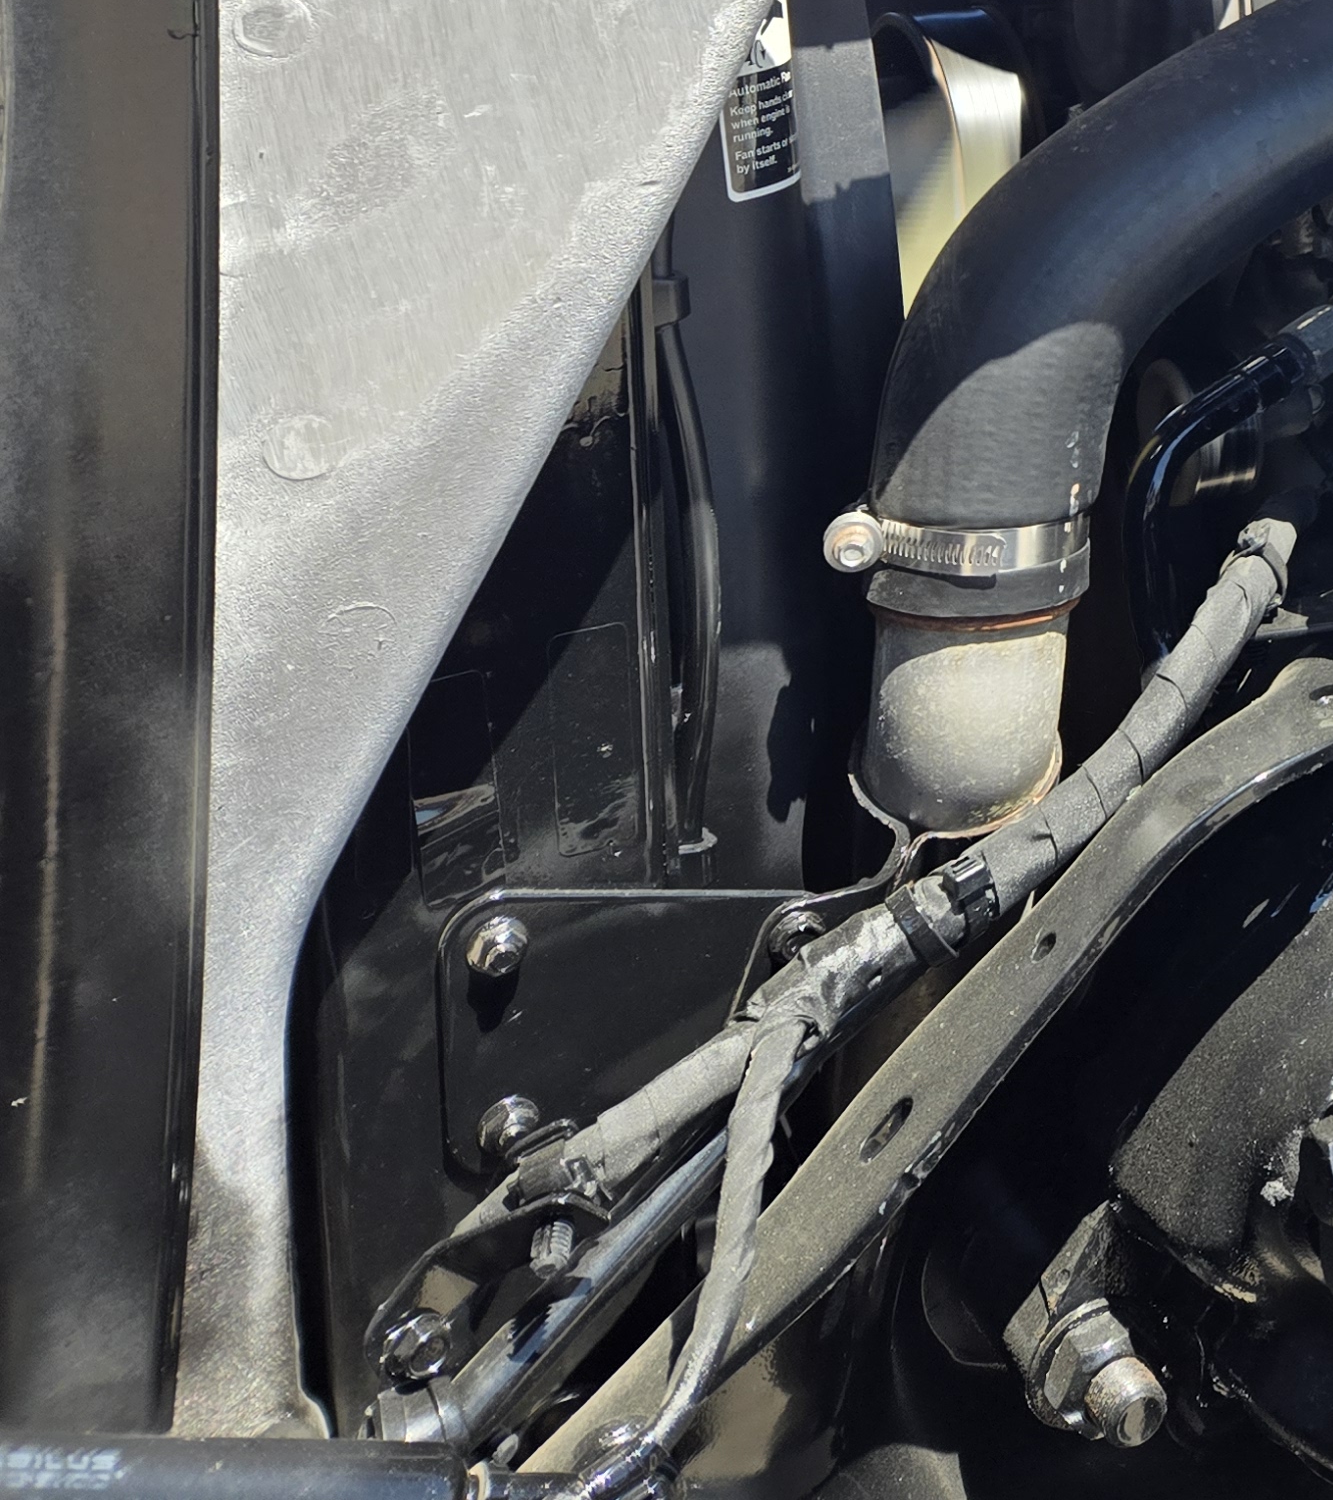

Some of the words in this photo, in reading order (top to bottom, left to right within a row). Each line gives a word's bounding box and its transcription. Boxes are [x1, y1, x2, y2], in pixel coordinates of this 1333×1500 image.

[729, 75, 780, 98] Automatic
[730, 104, 757, 117] Keep
[758, 95, 782, 110] hands
[731, 116, 759, 130] when
[761, 107, 785, 123] engine
[733, 126, 774, 143] running.
[735, 149, 755, 161] Fan
[756, 141, 781, 156] starts
[736, 164, 751, 175] by
[752, 154, 778, 171] itself.
